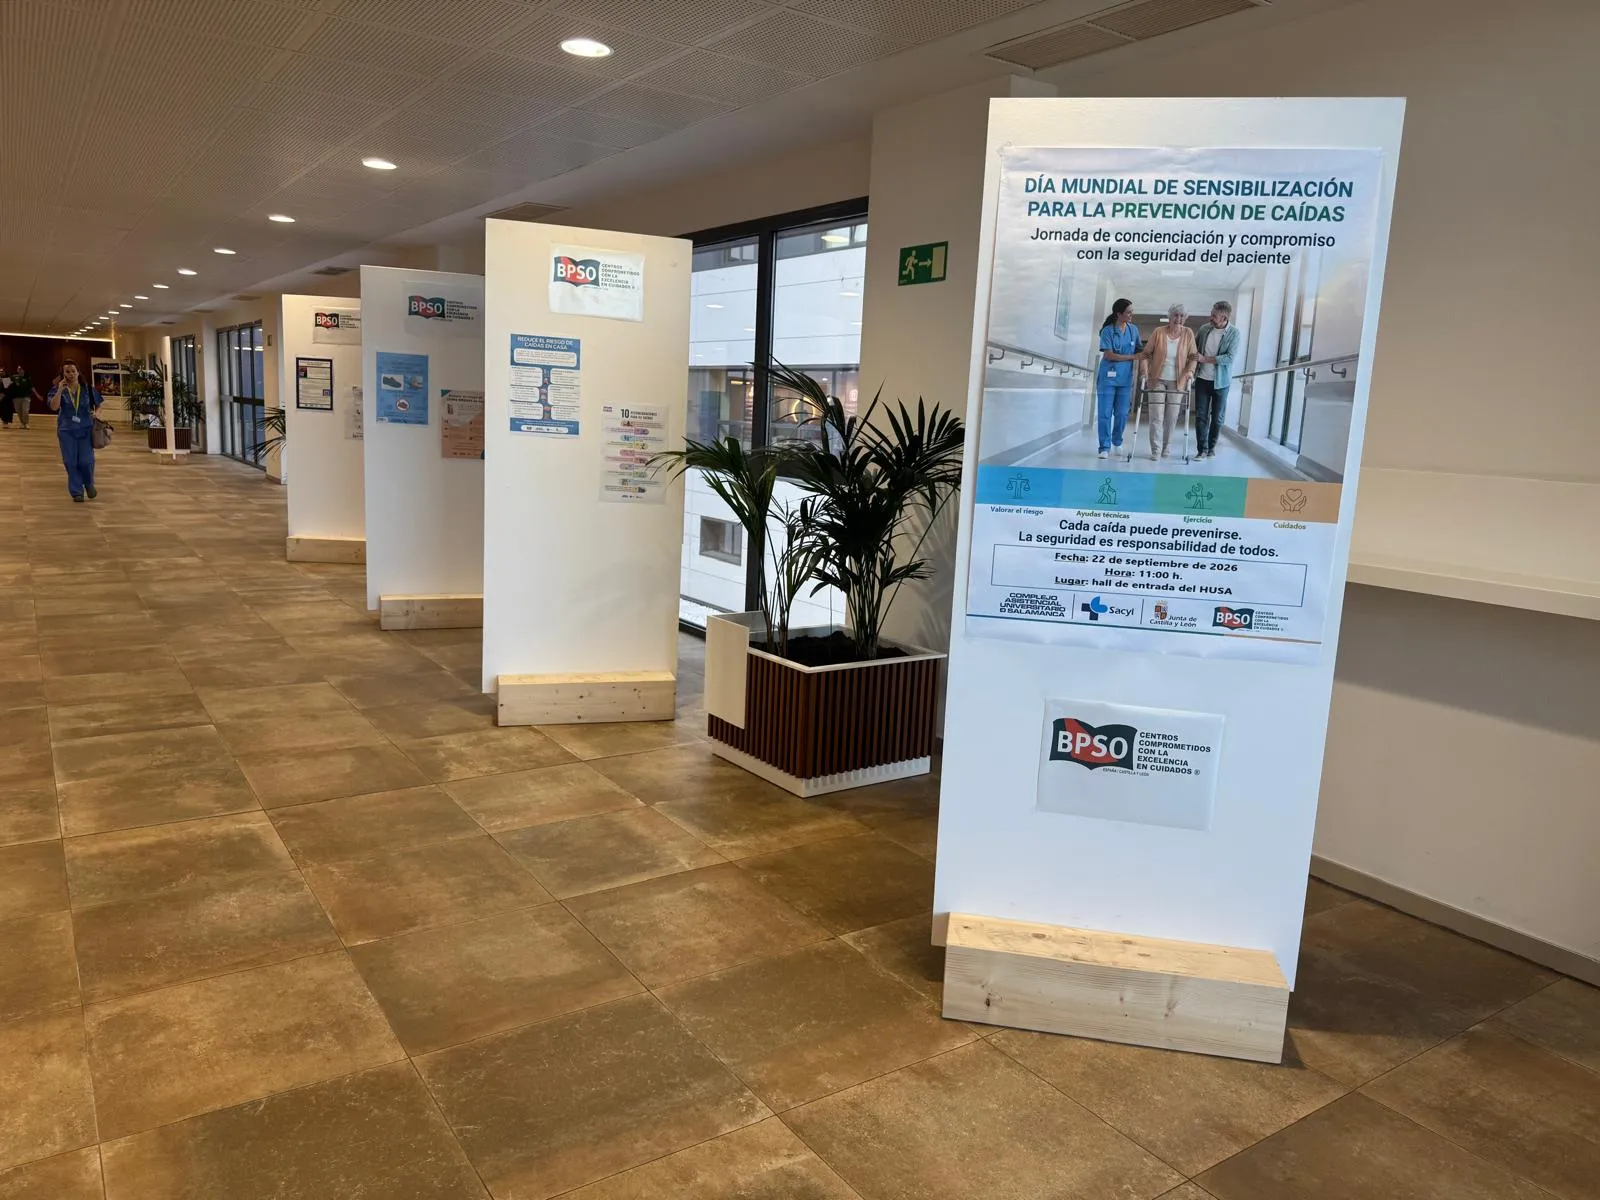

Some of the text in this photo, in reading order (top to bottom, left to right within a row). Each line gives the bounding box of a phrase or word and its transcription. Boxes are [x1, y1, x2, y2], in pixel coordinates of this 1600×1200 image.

[1025, 174, 1353, 197] DÍA MUNDIAL DE SENSIBILIZACIÓN
[1028, 200, 1345, 221] PARA LA PREVENCIÓN DE CAÍDAS
[1031, 228, 1335, 248] Jornada de concienciación y compromiso
[1077, 247, 1291, 266] con la seguridad del paciente
[557, 263, 596, 280] BPSO
[412, 301, 442, 313] BPSO
[317, 316, 337, 325] BPSO
[621, 409, 629, 418] 10
[1023, 508, 1043, 516] riesgo
[1076, 510, 1130, 519] Ayudas técnicas
[1183, 516, 1212, 524] Ejercicio
[1060, 520, 1242, 540] Cada caída puede prevenirse.
[1273, 522, 1306, 530] Cuidados
[1019, 531, 1278, 557] La seguridad es responsabilidad de todos.
[1055, 552, 1238, 572] Fecha: 22 de septiembre de 2026
[1105, 568, 1182, 580] Hora: 11:00 h.
[1055, 576, 1232, 595] Lugar: hall de entrada del HUSA
[1000, 602, 1065, 612] UNIVERSITARIO
[1005, 598, 1062, 606] ASISTENCIAL
[1007, 608, 1064, 617] SALAMANCA
[1109, 606, 1134, 616] Sacyl
[1216, 612, 1250, 625] BPSO
[1140, 731, 1179, 741] CENTROS
[1058, 730, 1128, 760] BPSO
[1139, 740, 1211, 752] COMPROMETIDOS
[1138, 748, 1156, 756] CON
[1137, 755, 1188, 766] EXCELENCIA
[1150, 764, 1192, 775] CUIDADOS
